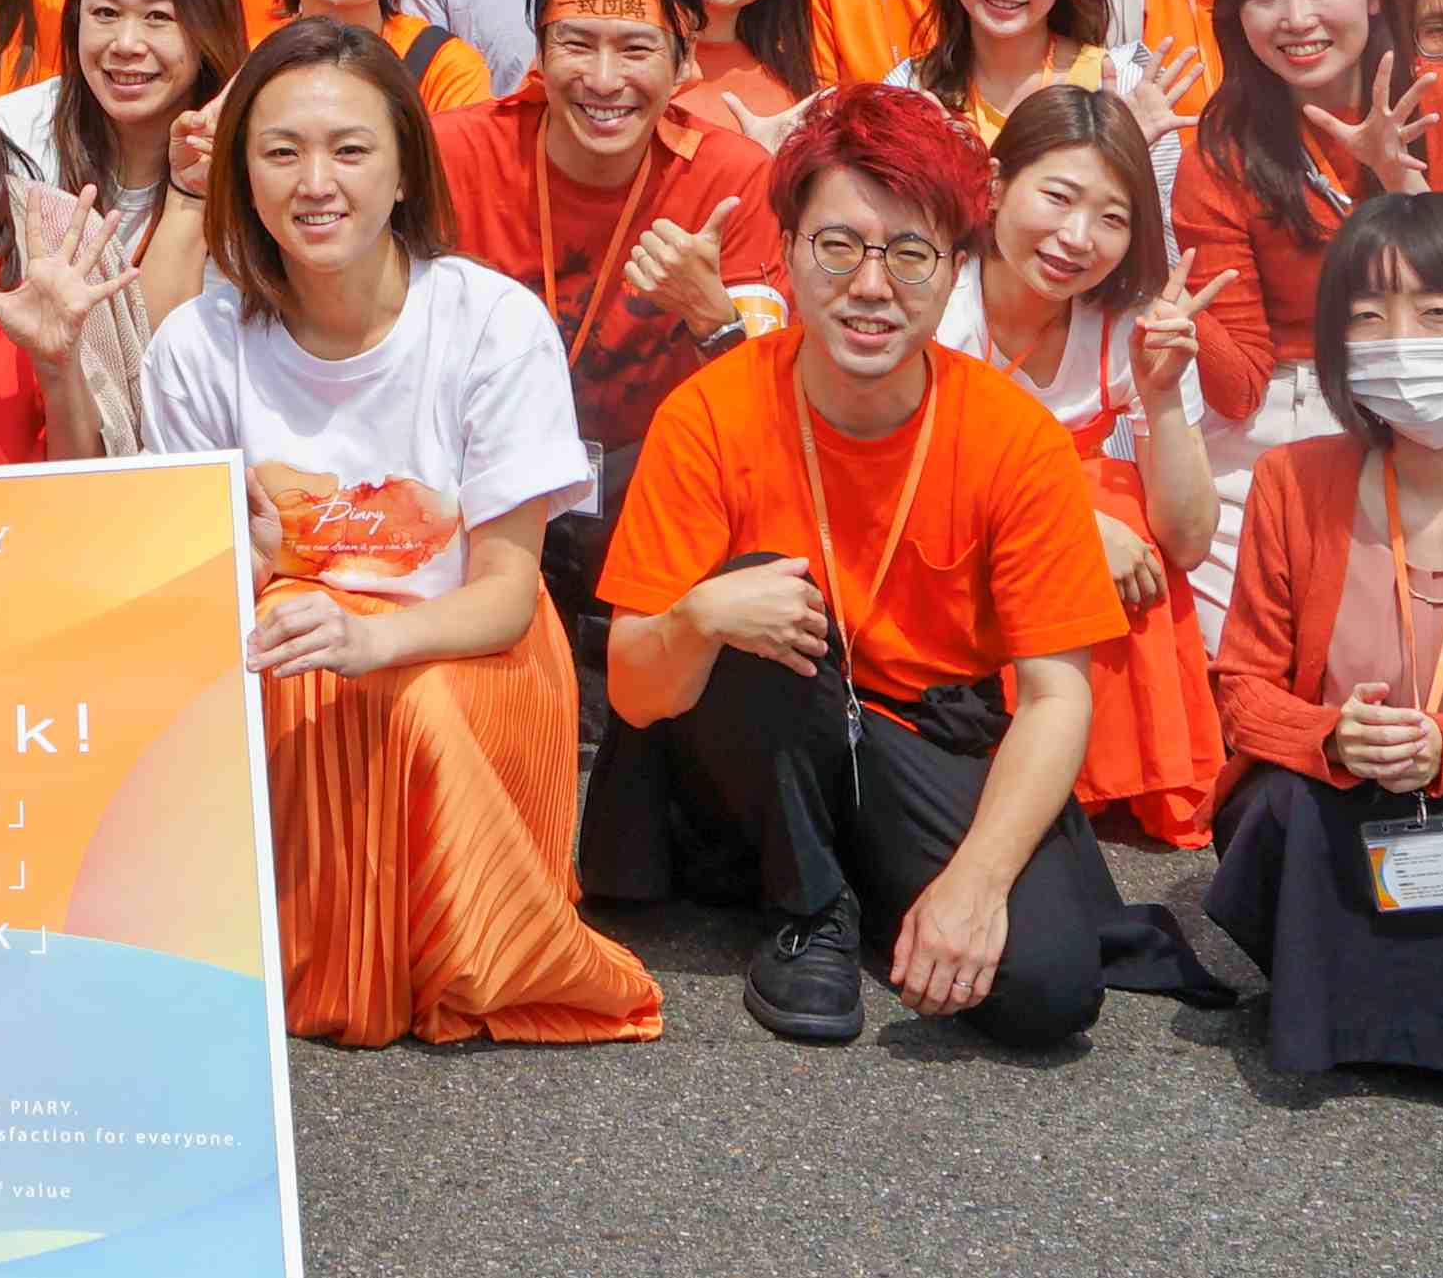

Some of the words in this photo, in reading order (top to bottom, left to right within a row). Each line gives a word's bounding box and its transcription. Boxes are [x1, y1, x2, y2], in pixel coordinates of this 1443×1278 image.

[313, 495, 386, 535] Piary
[11, 1100, 79, 1116] PIARY.
[96, 1128, 127, 1145] for
[135, 1132, 242, 1148] everyone.
[12, 1182, 72, 1200] value
